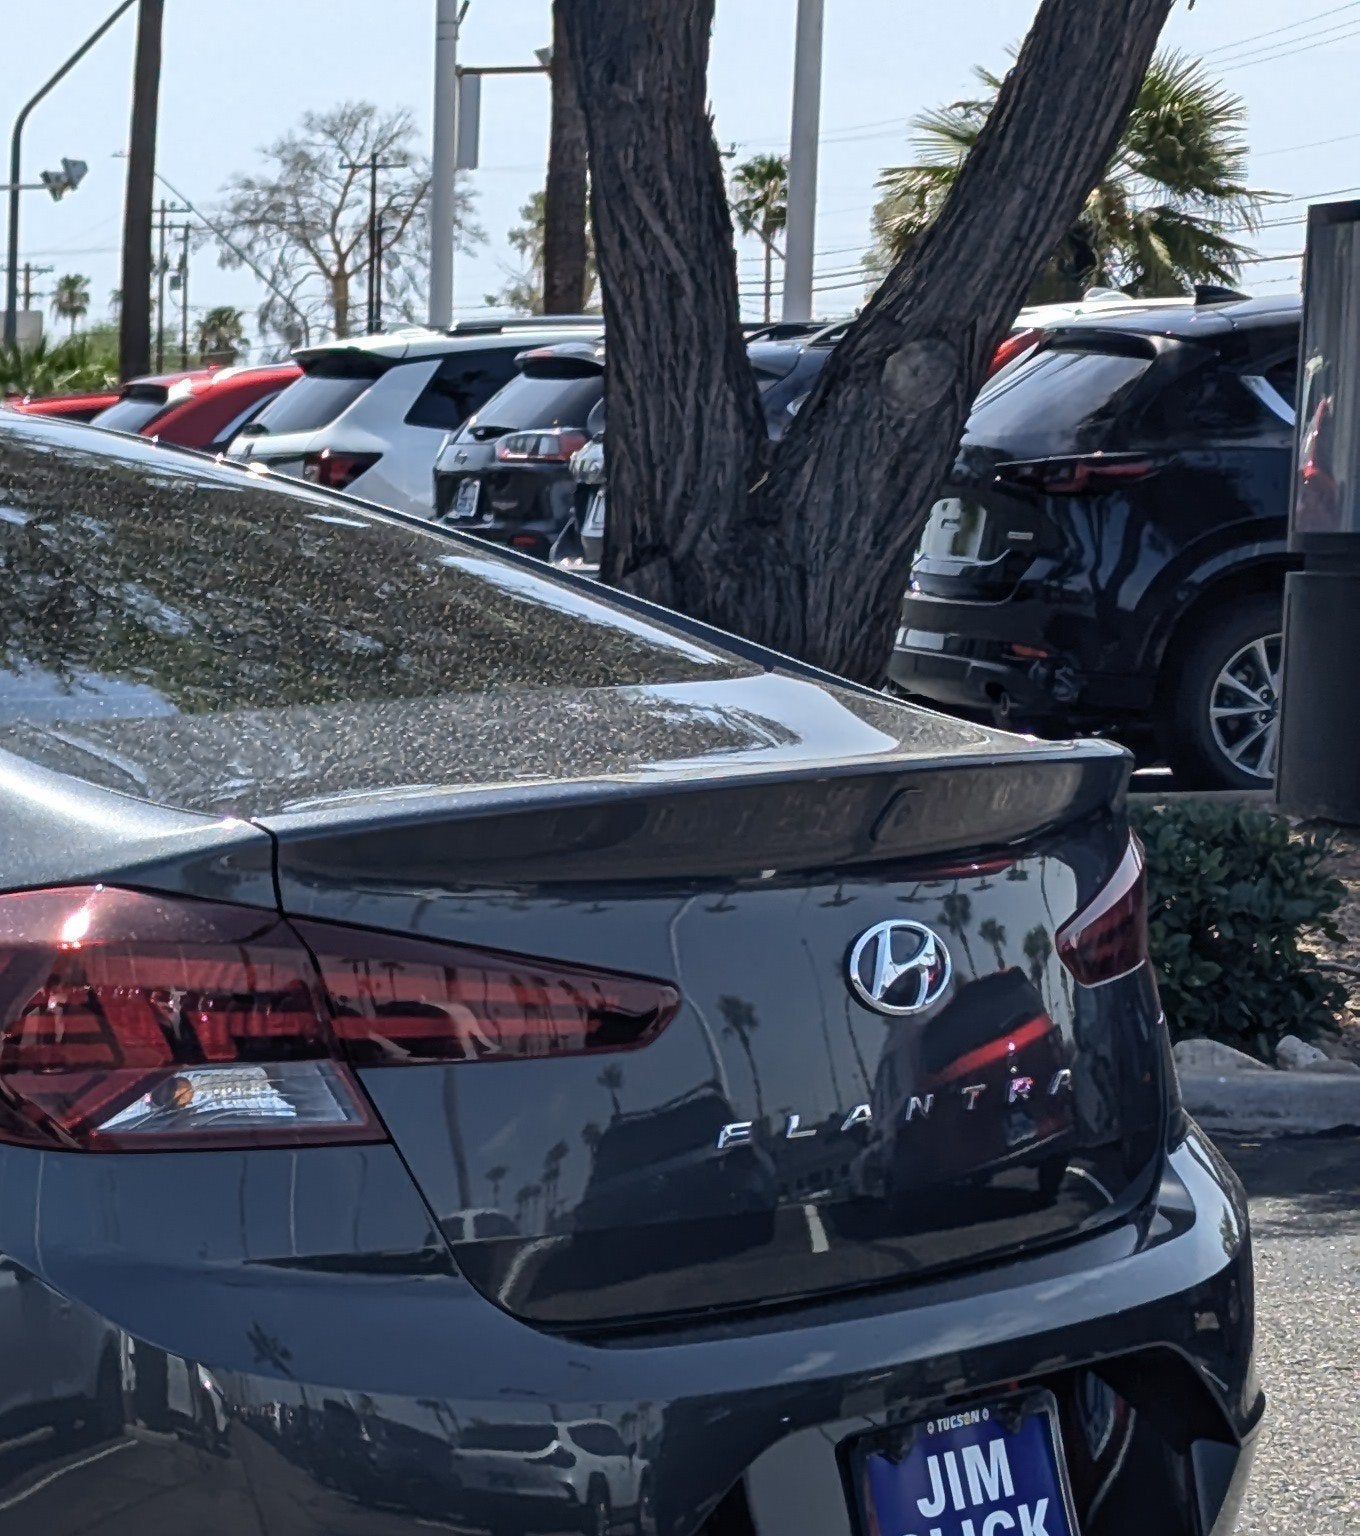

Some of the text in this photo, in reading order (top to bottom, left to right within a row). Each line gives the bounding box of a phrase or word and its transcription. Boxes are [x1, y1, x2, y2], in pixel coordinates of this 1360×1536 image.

[717, 1069, 1072, 1150] ELANTRA
[936, 1409, 980, 1433] TUCSON
[917, 1438, 1015, 1518] JIM
